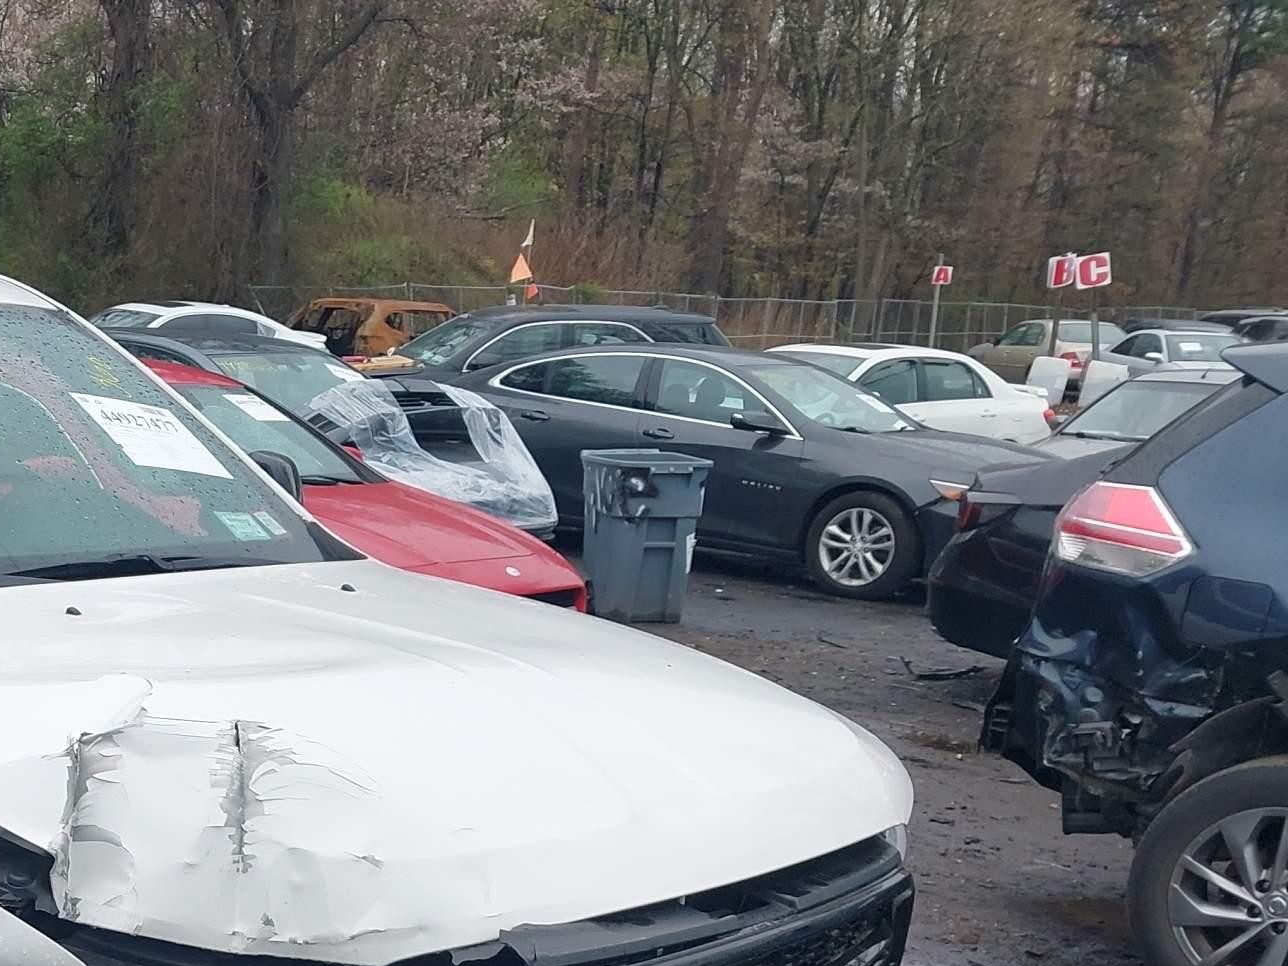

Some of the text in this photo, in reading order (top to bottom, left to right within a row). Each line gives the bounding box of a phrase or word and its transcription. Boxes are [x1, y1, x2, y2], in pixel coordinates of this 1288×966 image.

[935, 268, 949, 282] A
[1079, 255, 1108, 286] C
[100, 408, 178, 432] 44927477
